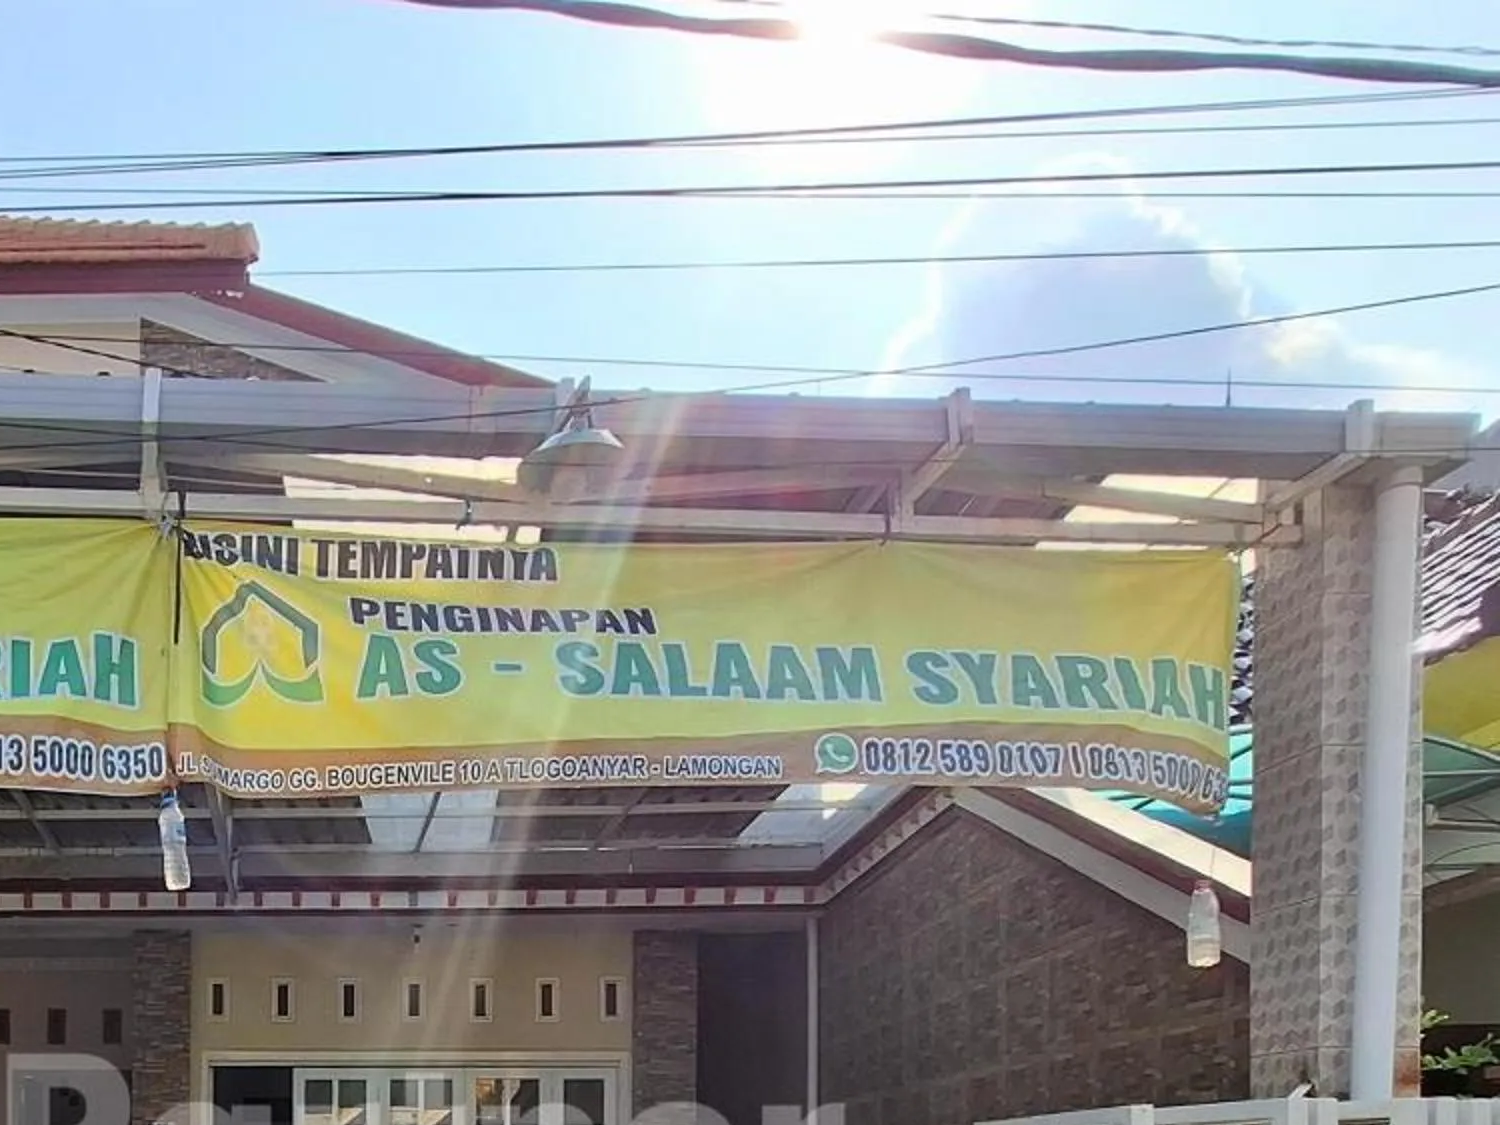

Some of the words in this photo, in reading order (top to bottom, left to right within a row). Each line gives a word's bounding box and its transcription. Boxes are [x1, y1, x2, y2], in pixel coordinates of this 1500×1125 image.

[311, 538, 558, 582] TEMPATNYA
[350, 596, 658, 636] PENGINAPAN
[357, 634, 462, 698] AS
[554, 640, 883, 702] SALAAM
[905, 650, 1226, 732] SYARIAH
[31, 738, 94, 778] 5000
[102, 743, 163, 783] 6350
[327, 762, 453, 787] BOUGENVILE
[506, 757, 646, 779] TLOGOANYAR
[665, 756, 782, 777] LAMONGAN
[864, 739, 932, 775] 0812
[940, 742, 989, 777] 589
[999, 743, 1062, 777] 0107
[1089, 746, 1146, 782] 0813
